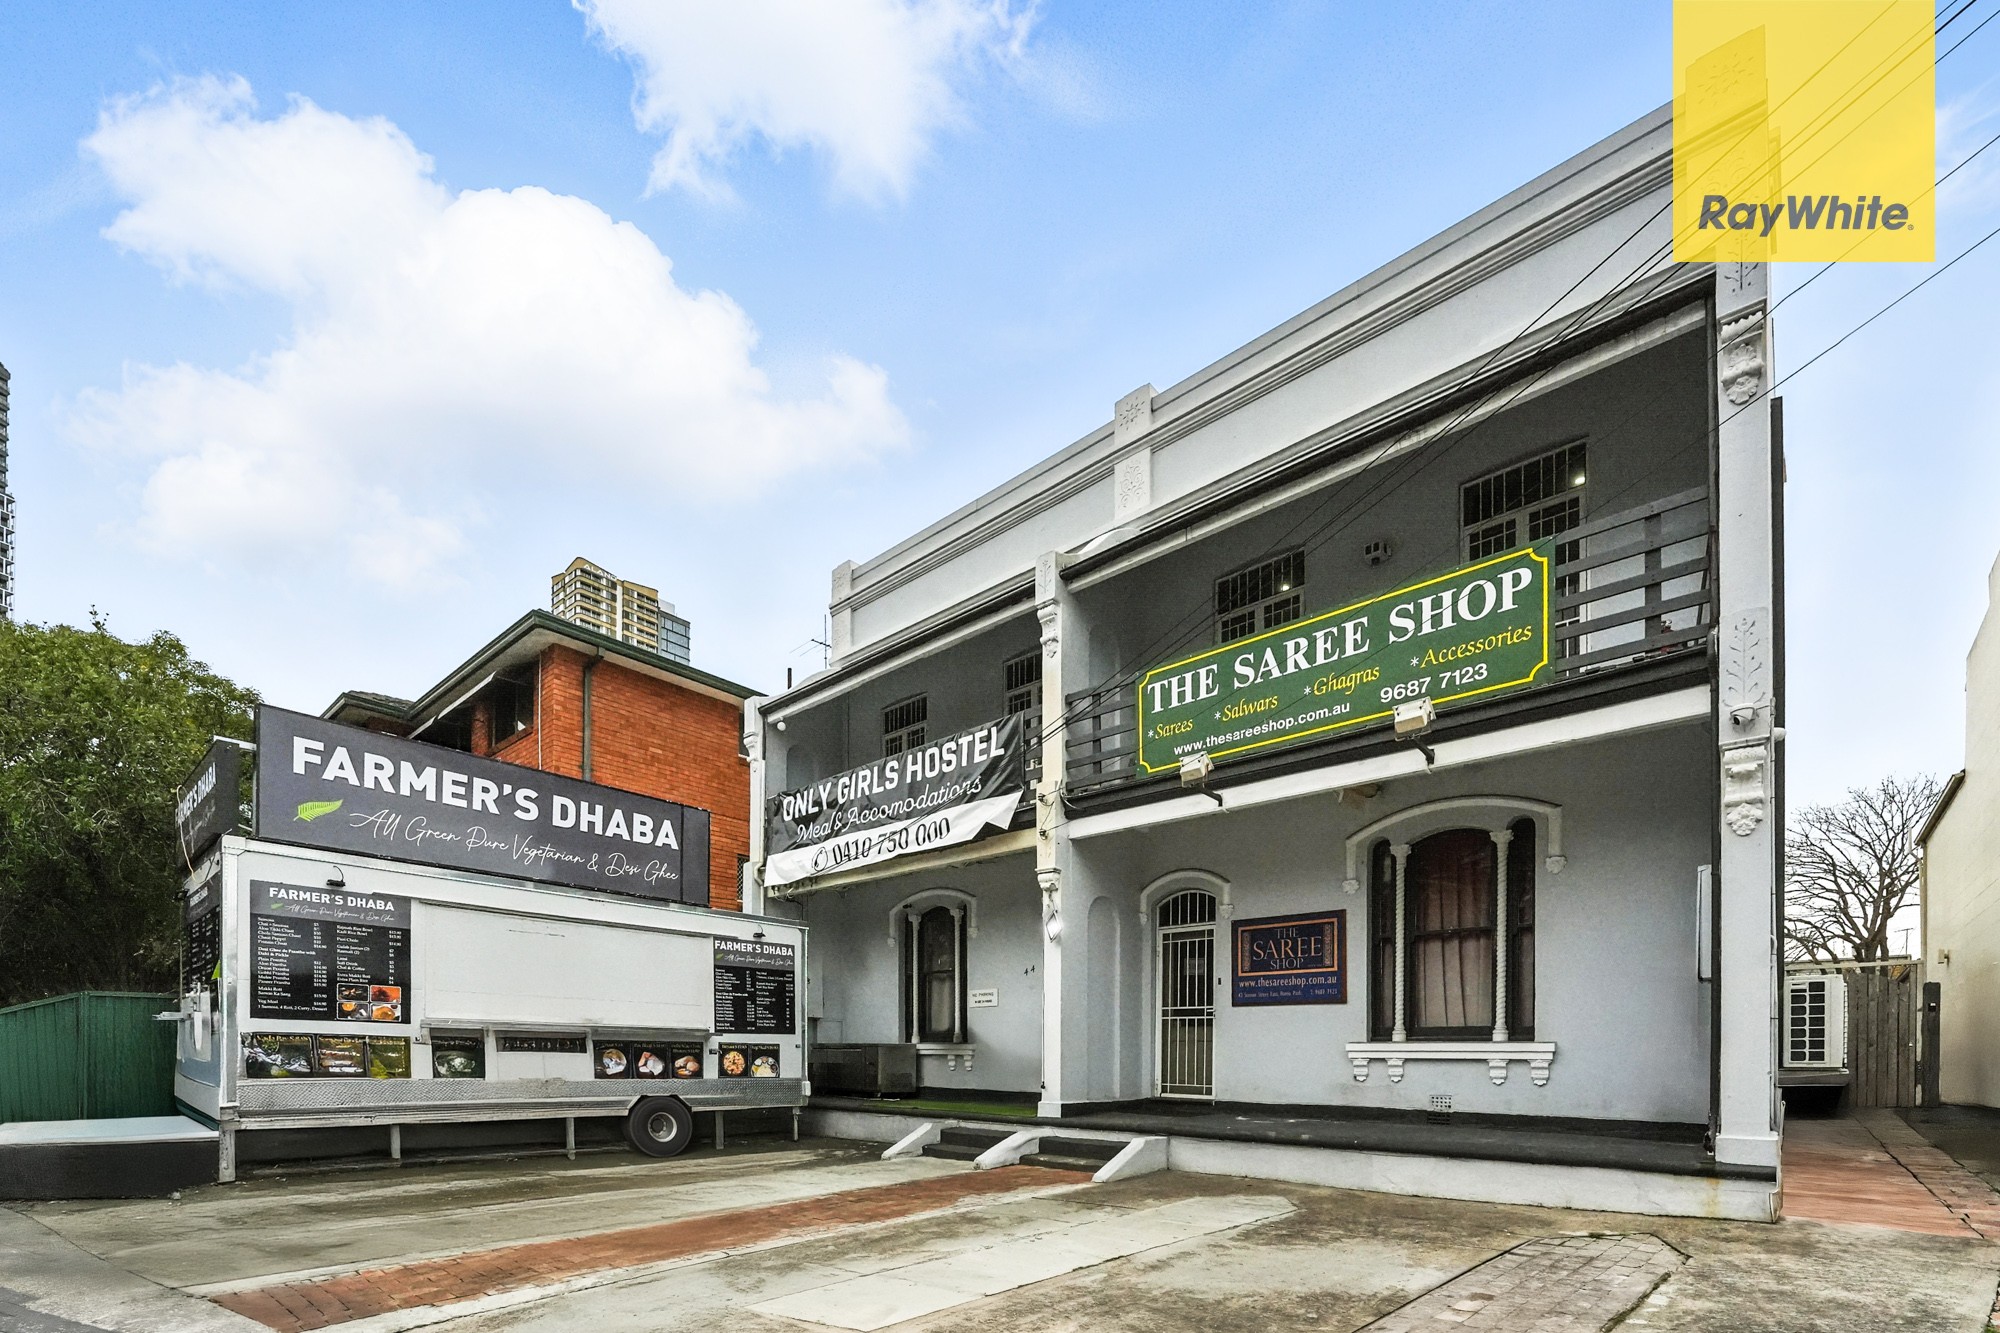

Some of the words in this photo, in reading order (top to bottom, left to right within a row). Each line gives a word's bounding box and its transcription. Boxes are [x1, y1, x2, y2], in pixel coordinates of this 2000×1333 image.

[1147, 664, 1219, 713] THE
[1233, 617, 1370, 690] SAREE
[1389, 567, 1533, 645] SHOP
[1420, 625, 1533, 669] Accessories
[1313, 666, 1380, 695] Ghagras
[1380, 677, 1432, 703] 9687
[1439, 663, 1488, 689] 7123
[1223, 695, 1278, 721] Salwars
[1155, 718, 1193, 739] Sarees
[1173, 702, 1350, 755] www.thesareeshop.com.au
[782, 781, 832, 822] ONLY
[837, 759, 899, 805] GIRLS
[905, 726, 1005, 784] HOSTEL
[293, 735, 539, 821] FARMER'S
[552, 795, 679, 850] DHABA
[842, 775, 982, 833] Accomodations
[350, 809, 402, 841] All
[405, 816, 461, 847] Green
[465, 826, 509, 851] Pure
[586, 853, 599, 873] &
[605, 852, 642, 877] Desi
[644, 860, 679, 886] Ghee
[832, 835, 871, 866] 0410
[915, 817, 951, 846] 000
[269, 887, 344, 905] FARMER'S
[347, 896, 394, 911] DHABA
[714, 940, 761, 953] FARMER'S
[763, 945, 793, 956] DHABA
[1253, 936, 1322, 961] SAREE
[1275, 926, 1299, 939] THE
[1270, 958, 1303, 970] SHOP
[1239, 976, 1337, 988] www.thesareeshop.com.au
